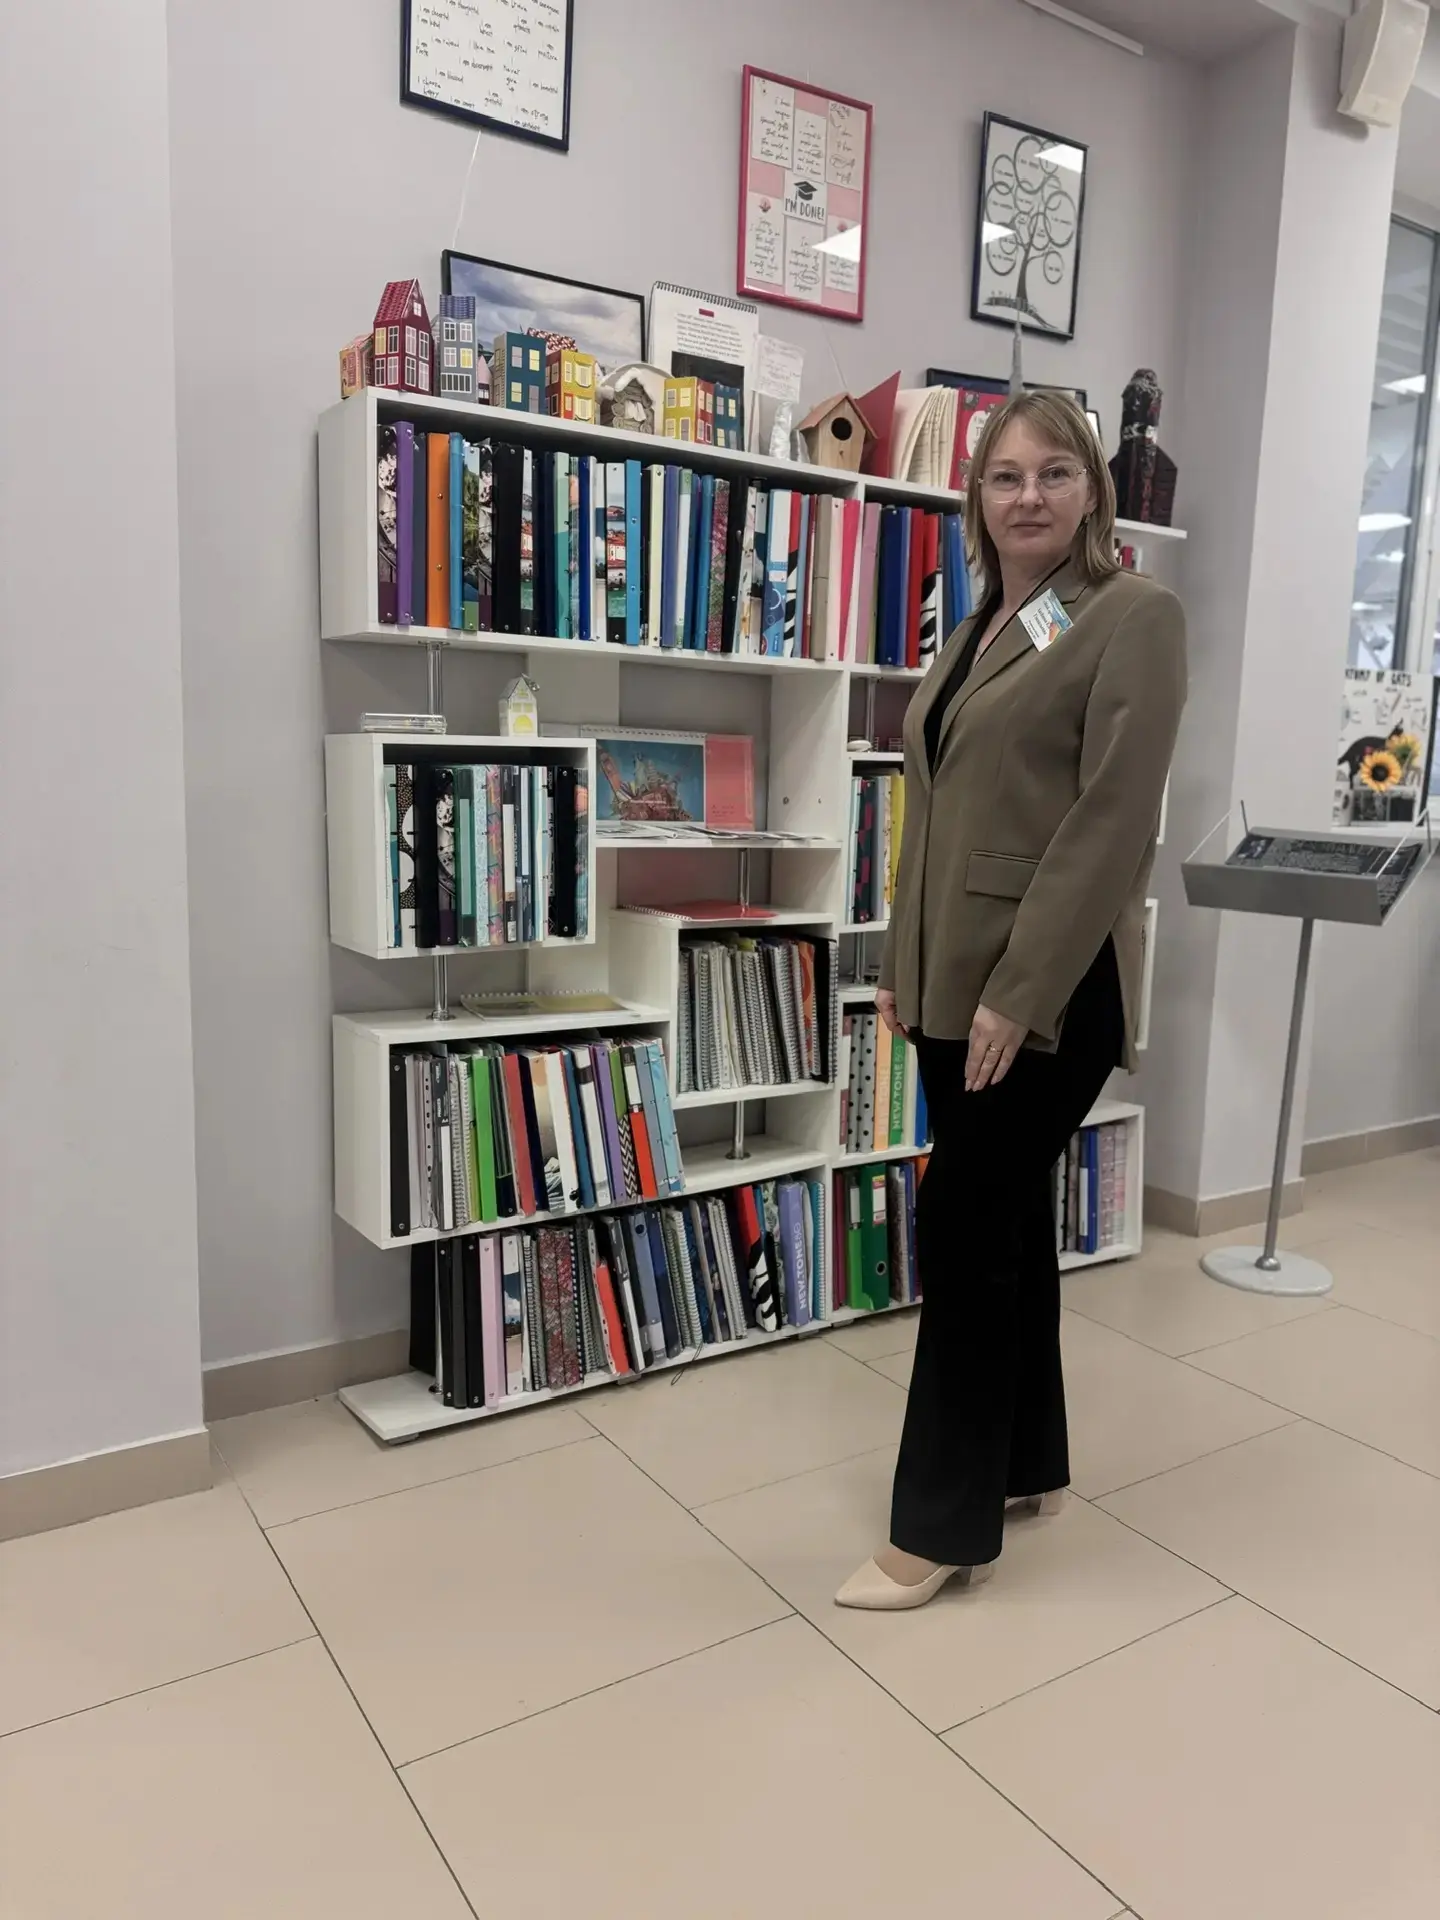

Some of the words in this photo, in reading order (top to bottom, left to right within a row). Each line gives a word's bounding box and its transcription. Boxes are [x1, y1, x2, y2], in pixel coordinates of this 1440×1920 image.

[784, 198, 798, 215] I'M
[800, 202, 824, 220] DONE!
[1376, 671, 1384, 683] OF
[1392, 673, 1412, 686] CATS
[793, 1241, 807, 1310] NEW.TONE
